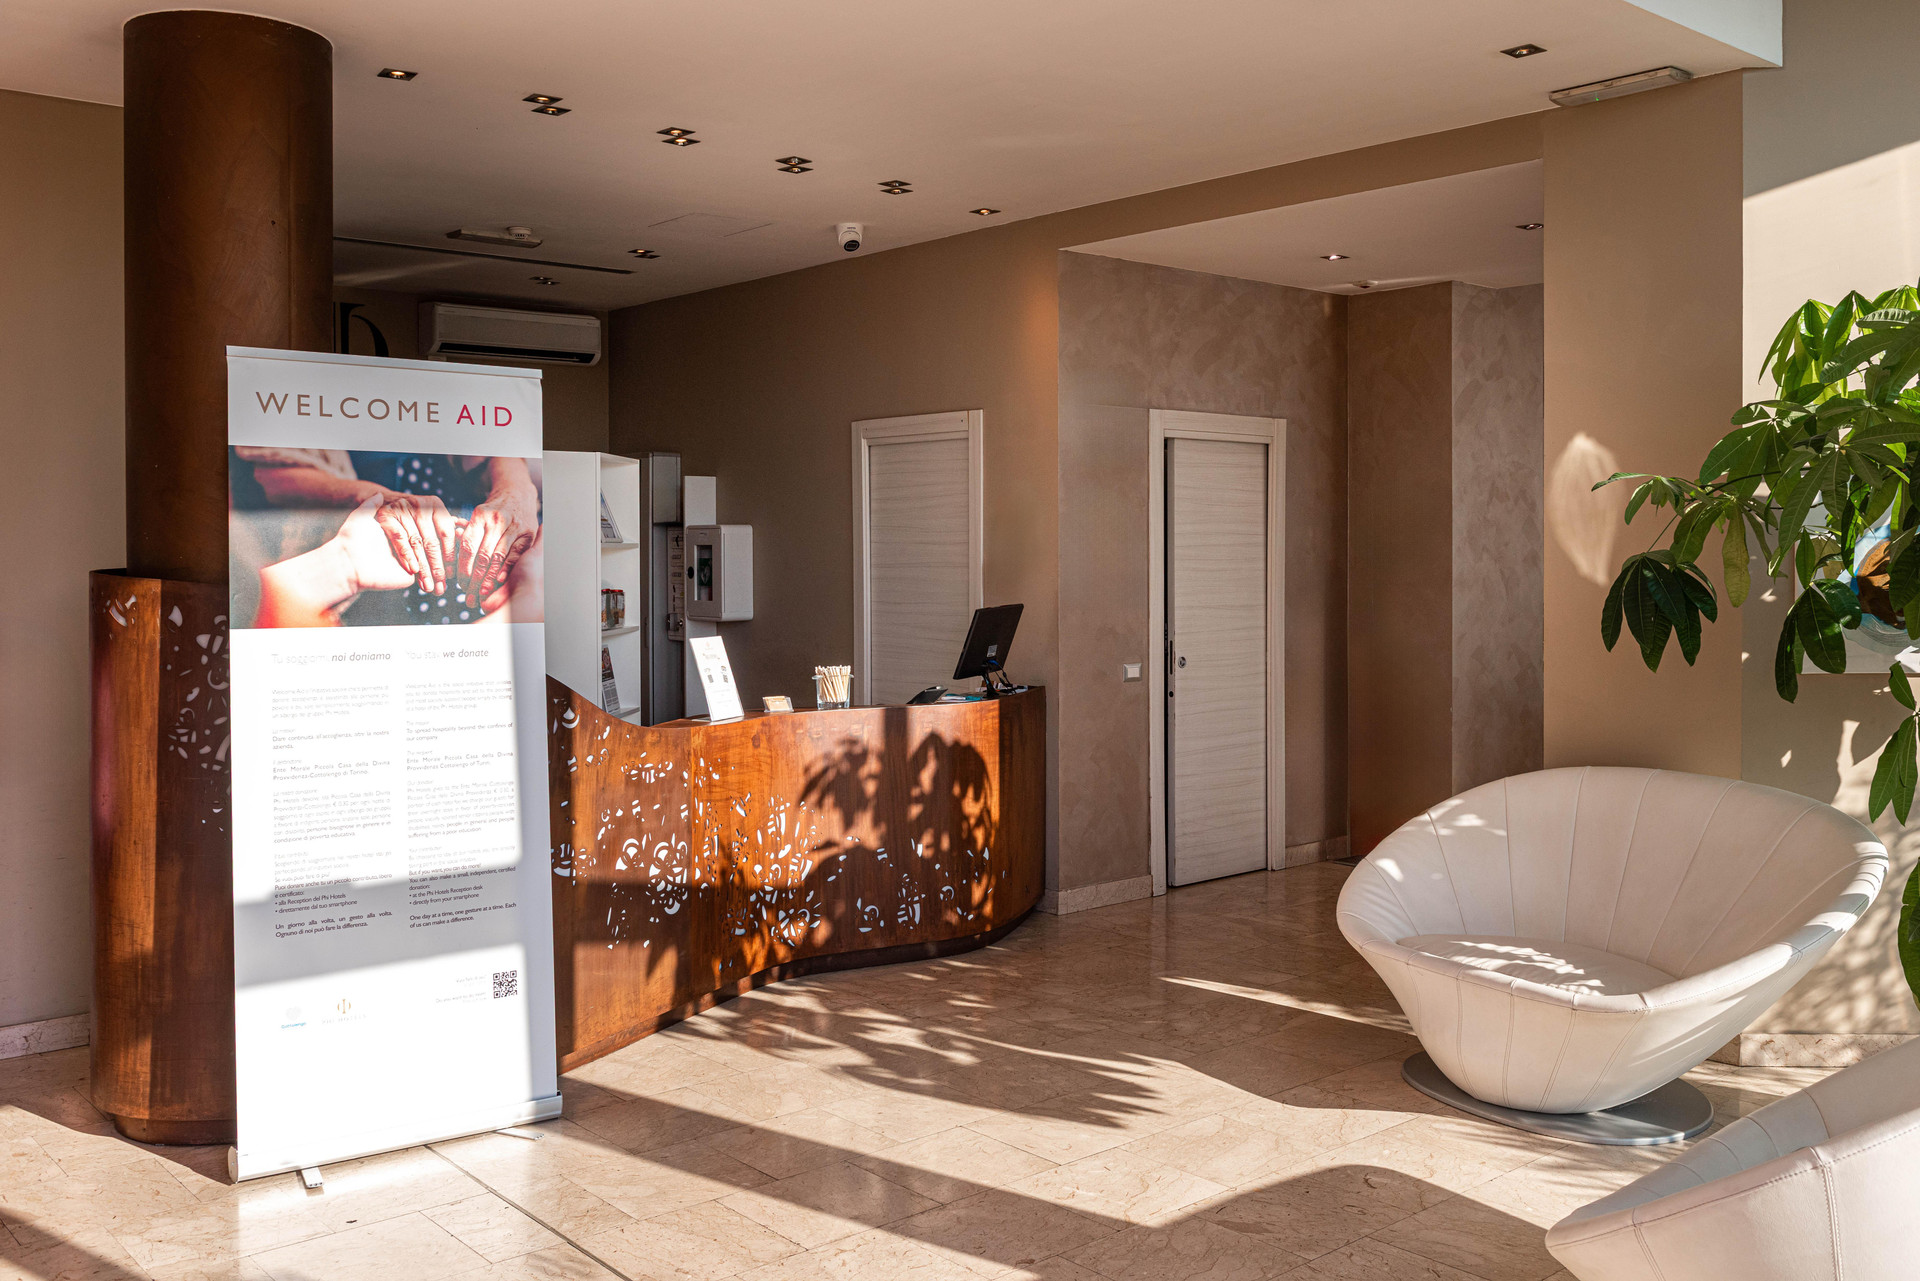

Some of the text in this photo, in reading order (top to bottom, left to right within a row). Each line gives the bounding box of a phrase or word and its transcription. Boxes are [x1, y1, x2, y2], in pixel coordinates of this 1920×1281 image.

[256, 391, 514, 427] WELCOME AID
[331, 652, 347, 662] noi
[349, 652, 391, 662] doniamo
[458, 649, 489, 658] donate
[450, 885, 472, 894] Reception
[287, 896, 312, 905] Reception
[412, 897, 429, 905] directly
[453, 892, 480, 900] smartphone
[278, 904, 310, 914] direttamente
[328, 900, 358, 908] smartphone
[464, 907, 482, 915] gesture
[505, 901, 517, 909] Each
[287, 922, 305, 930] giorno
[349, 914, 364, 923] gesto
[275, 930, 298, 938] Ognuno
